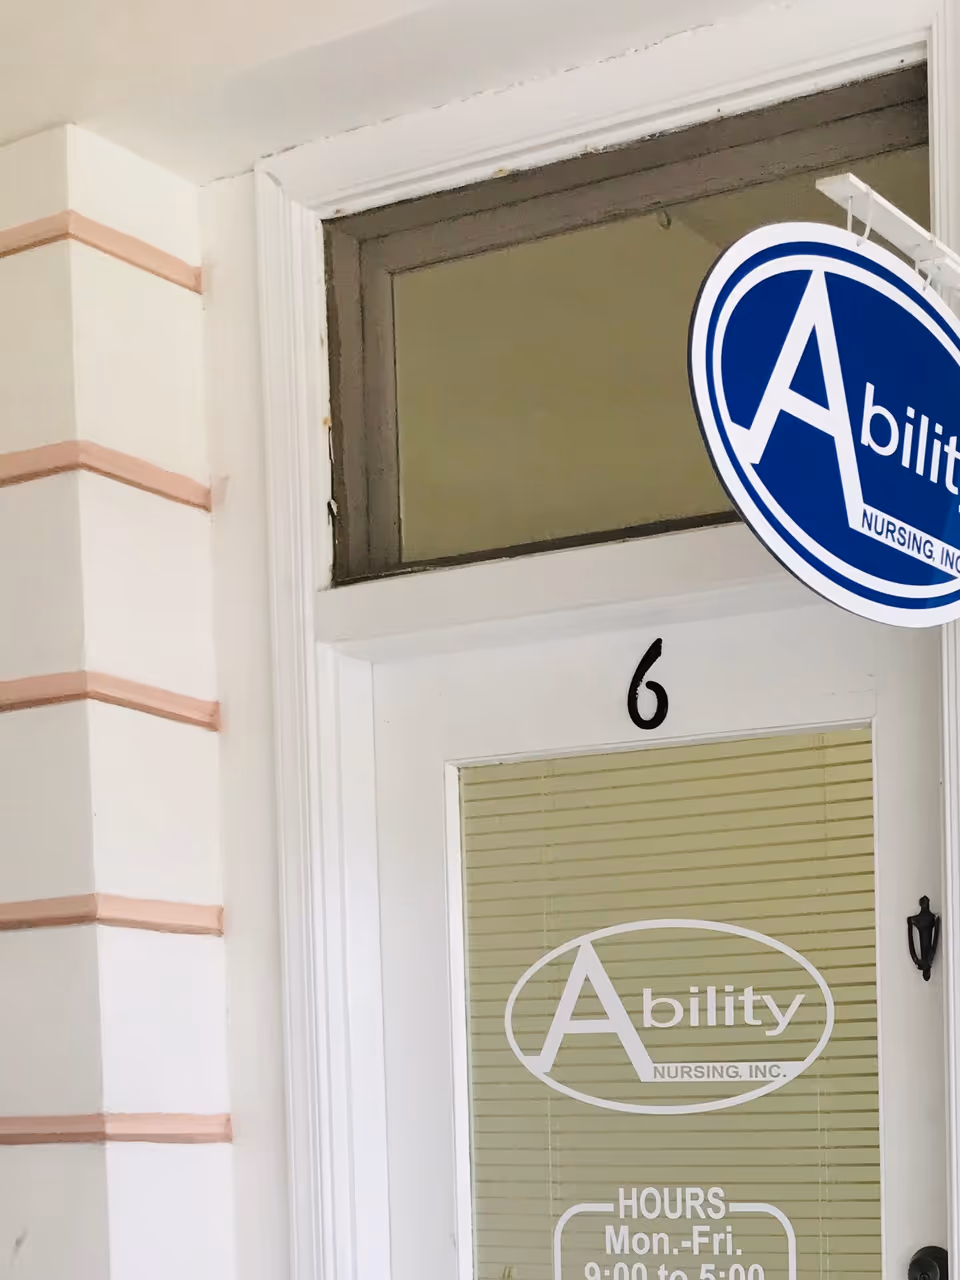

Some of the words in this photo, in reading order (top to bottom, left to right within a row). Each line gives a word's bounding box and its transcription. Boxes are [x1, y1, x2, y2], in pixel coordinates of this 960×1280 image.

[861, 508, 936, 562] NURSING,
[627, 637, 669, 730] 6
[523, 940, 807, 1083] Ability
[652, 1064, 743, 1080] NURSING,
[748, 1064, 787, 1079] INC.
[618, 1186, 726, 1220] HOURS
[605, 1224, 742, 1256] Mon.-Fri.
